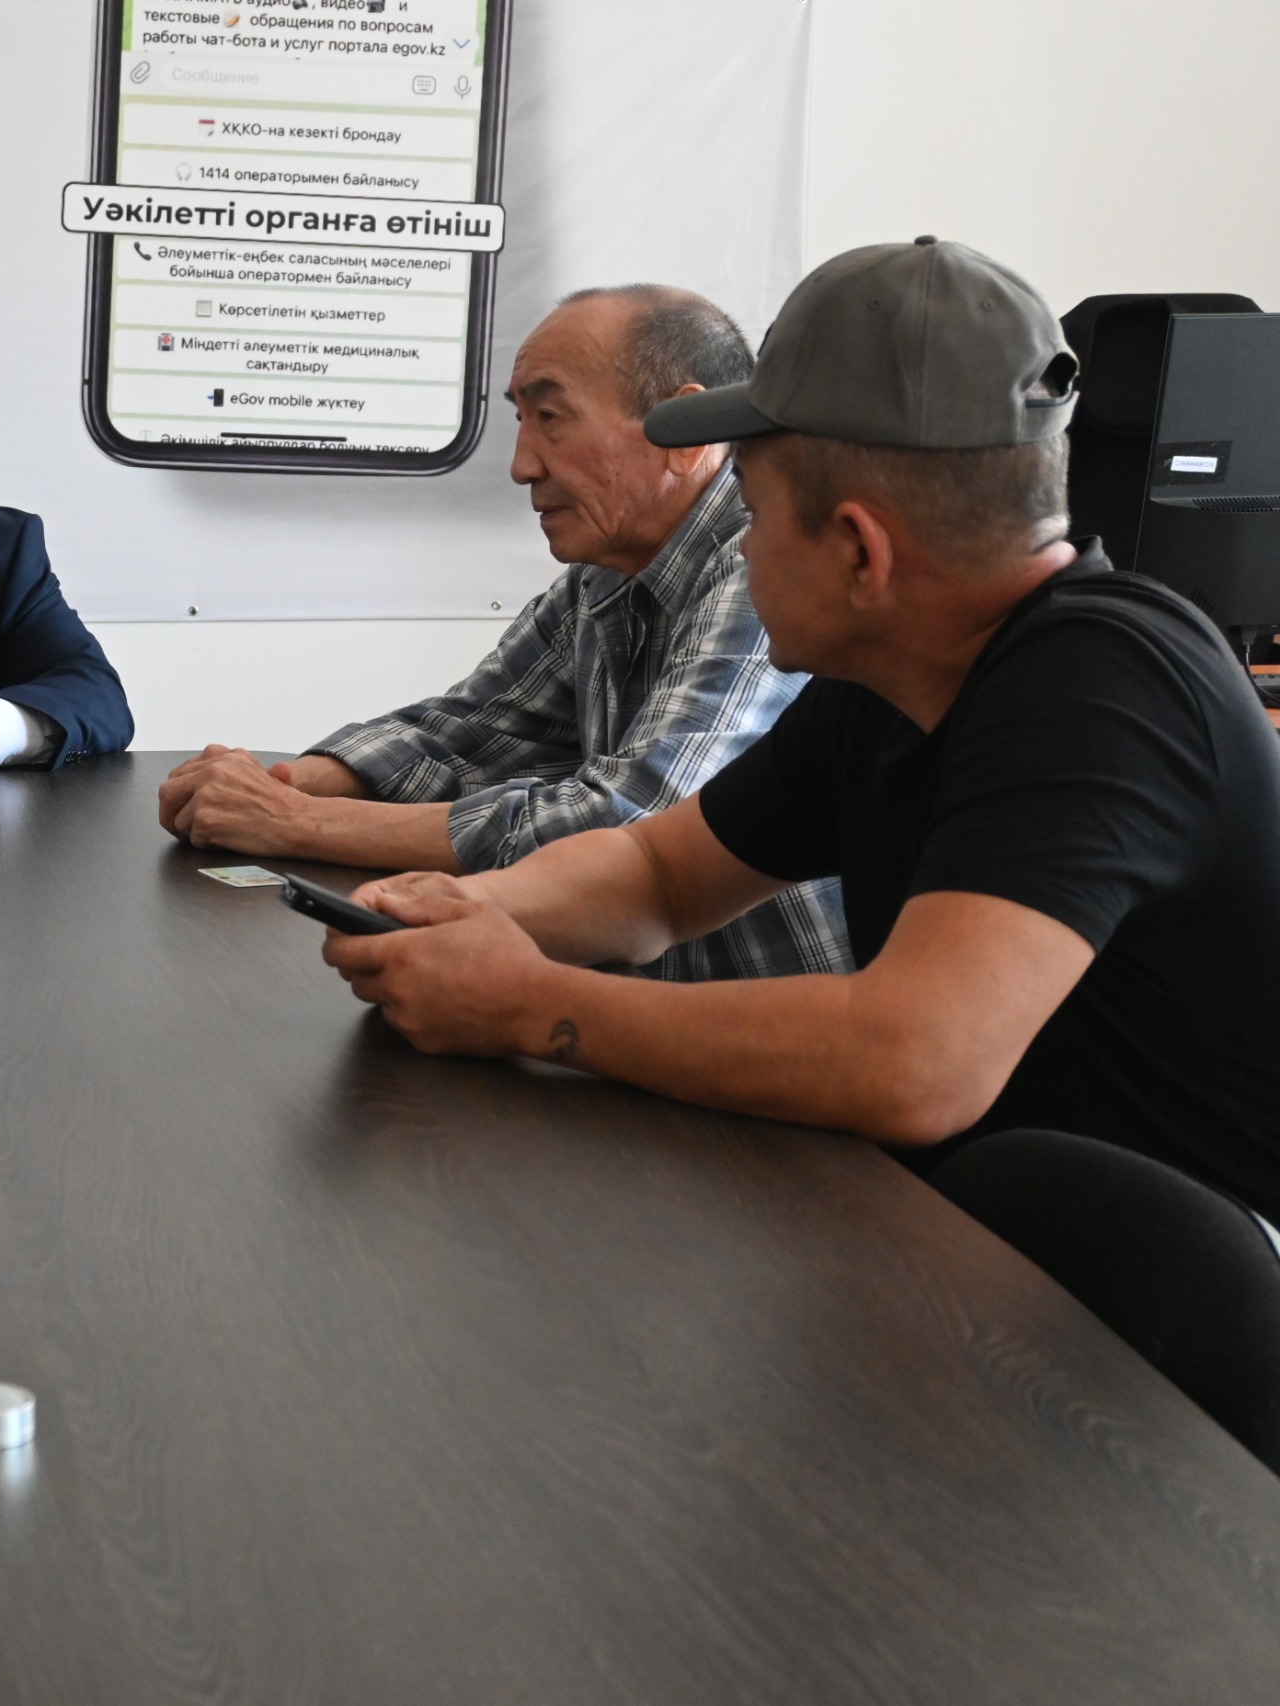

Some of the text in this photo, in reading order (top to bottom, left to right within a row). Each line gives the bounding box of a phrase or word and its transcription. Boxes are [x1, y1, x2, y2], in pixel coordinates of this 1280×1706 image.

[143, 11, 433, 34] текстовые обращения по вопросам
[143, 30, 446, 57] работы чат-бота и услуг портала egov.kz
[289, 125, 340, 140] кезекті
[342, 127, 402, 144] брондау
[198, 167, 420, 190] 1414 операторымен байланысу
[83, 196, 492, 238] Уәкілетті органға өтініш
[157, 245, 451, 274] Әлеуметтік-еңбек саласының мәселелері
[169, 264, 412, 290] бойынша оператормен байланысу
[219, 303, 386, 324] Көрсетілетін қызметтер
[181, 336, 420, 360] Міндетті әлеуметтік медициналық
[246, 357, 329, 375] сақтандыру
[230, 392, 366, 411] eGov mobile жүктеу
